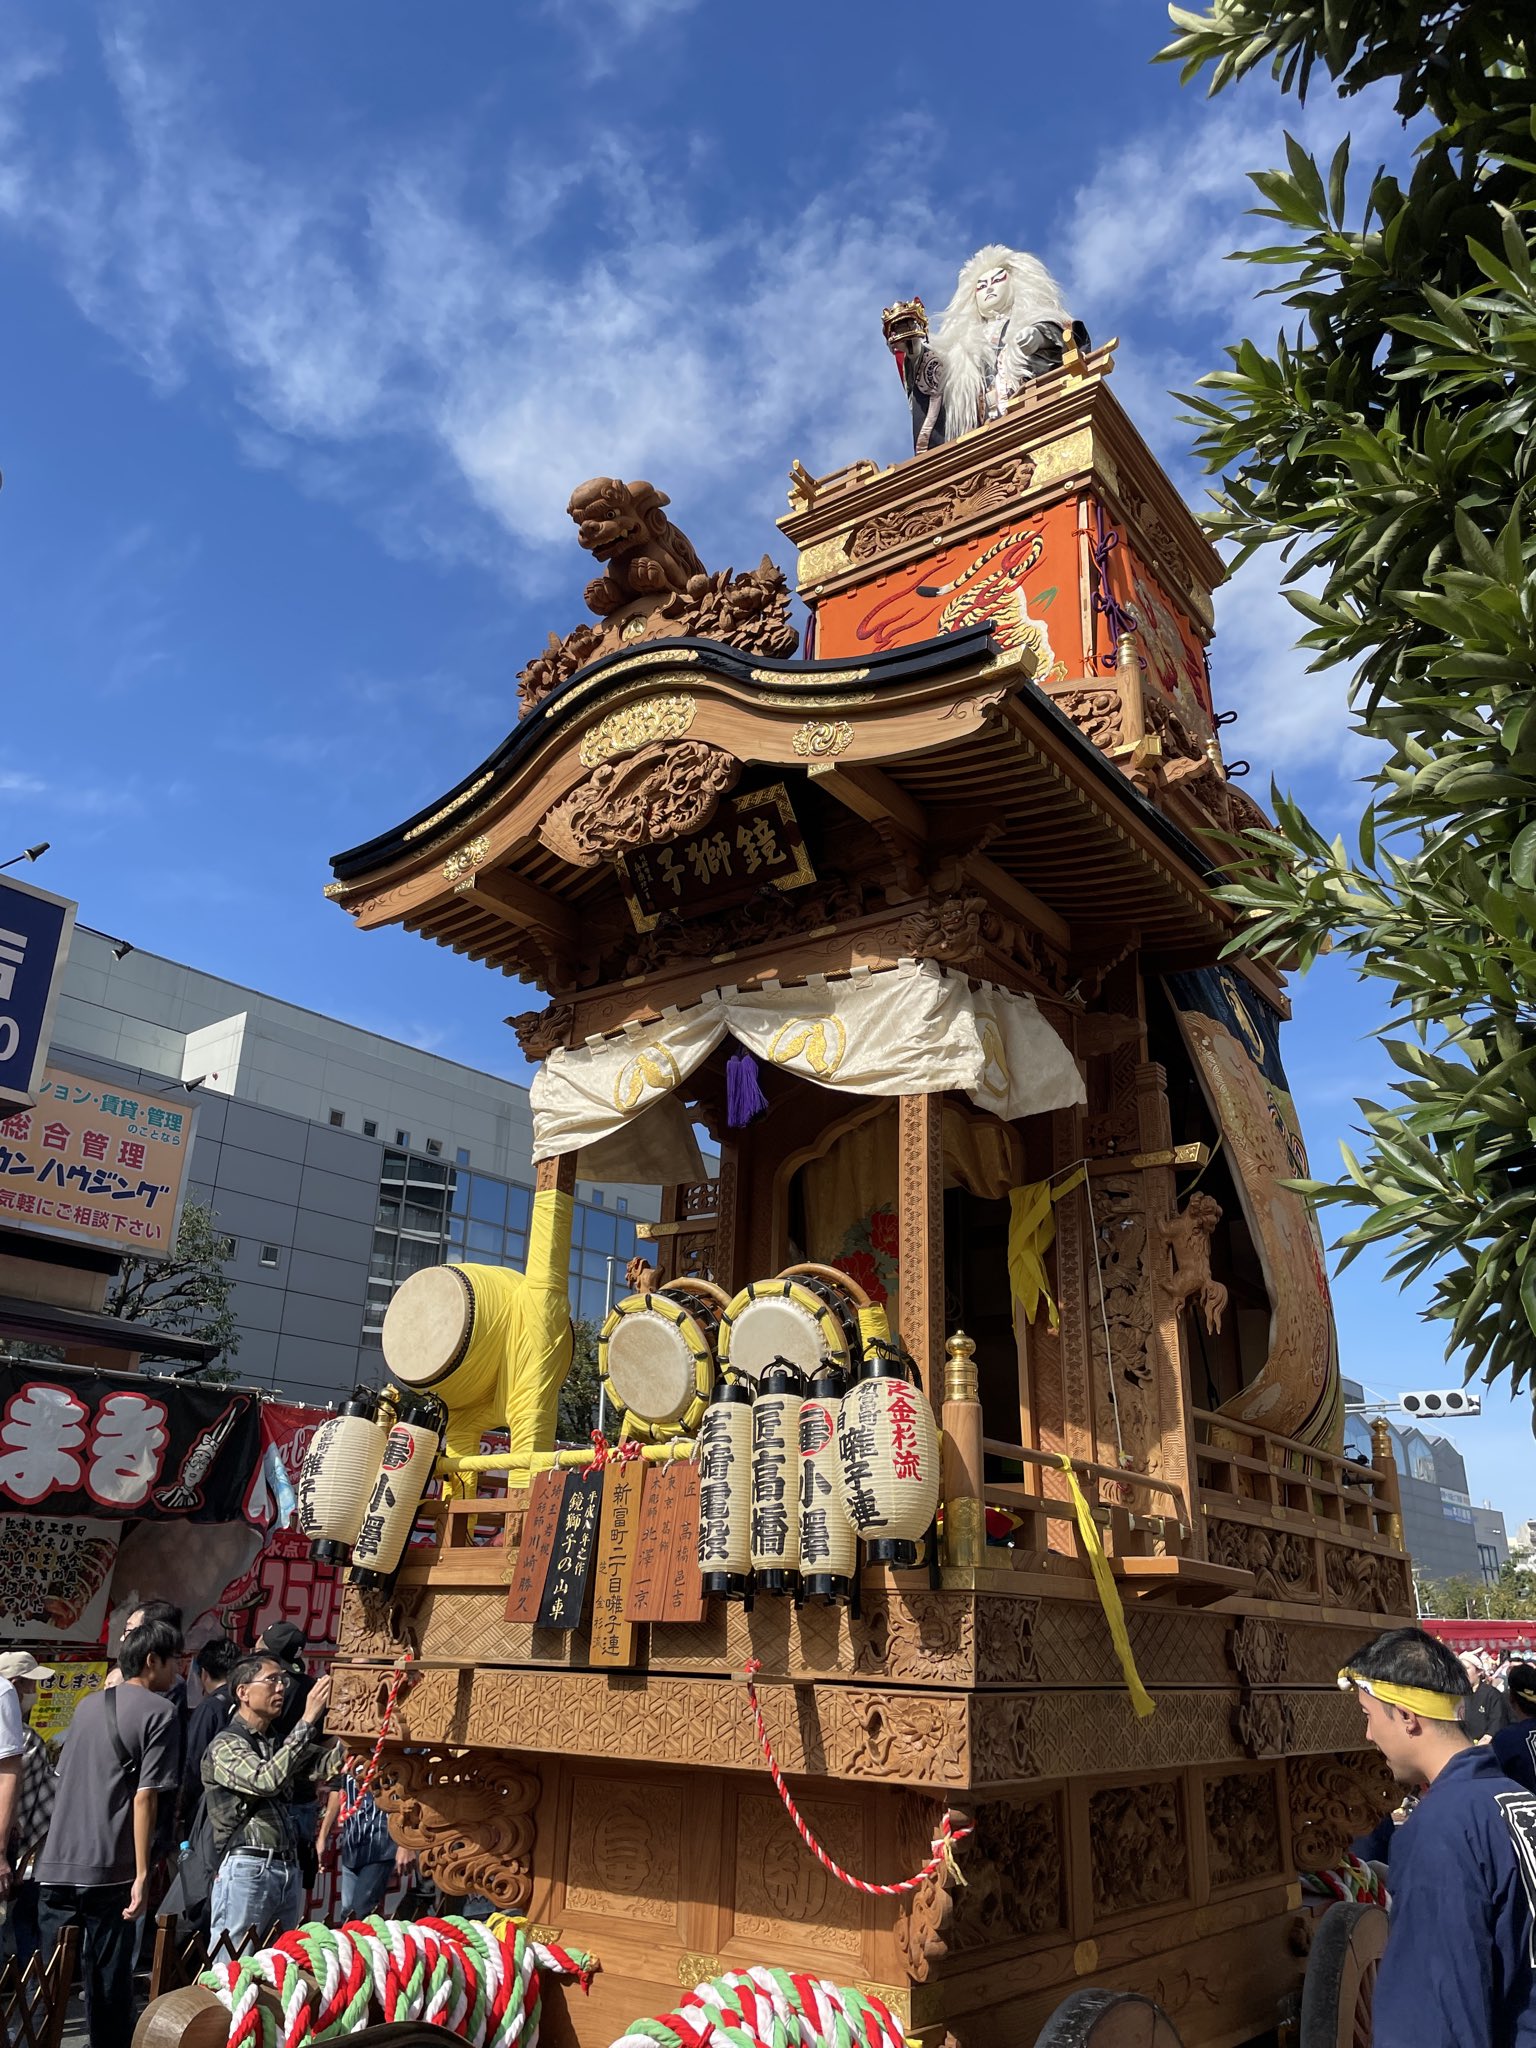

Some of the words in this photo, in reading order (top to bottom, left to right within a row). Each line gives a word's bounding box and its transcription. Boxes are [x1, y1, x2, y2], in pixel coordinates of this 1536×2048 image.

[656, 817, 788, 896] 鏡獅子
[1, 1113, 146, 1170] 総合管理
[128, 1124, 181, 1146] のことなら
[0, 1387, 166, 1504] まき
[549, 1491, 585, 1621] 鏡獅子の山車
